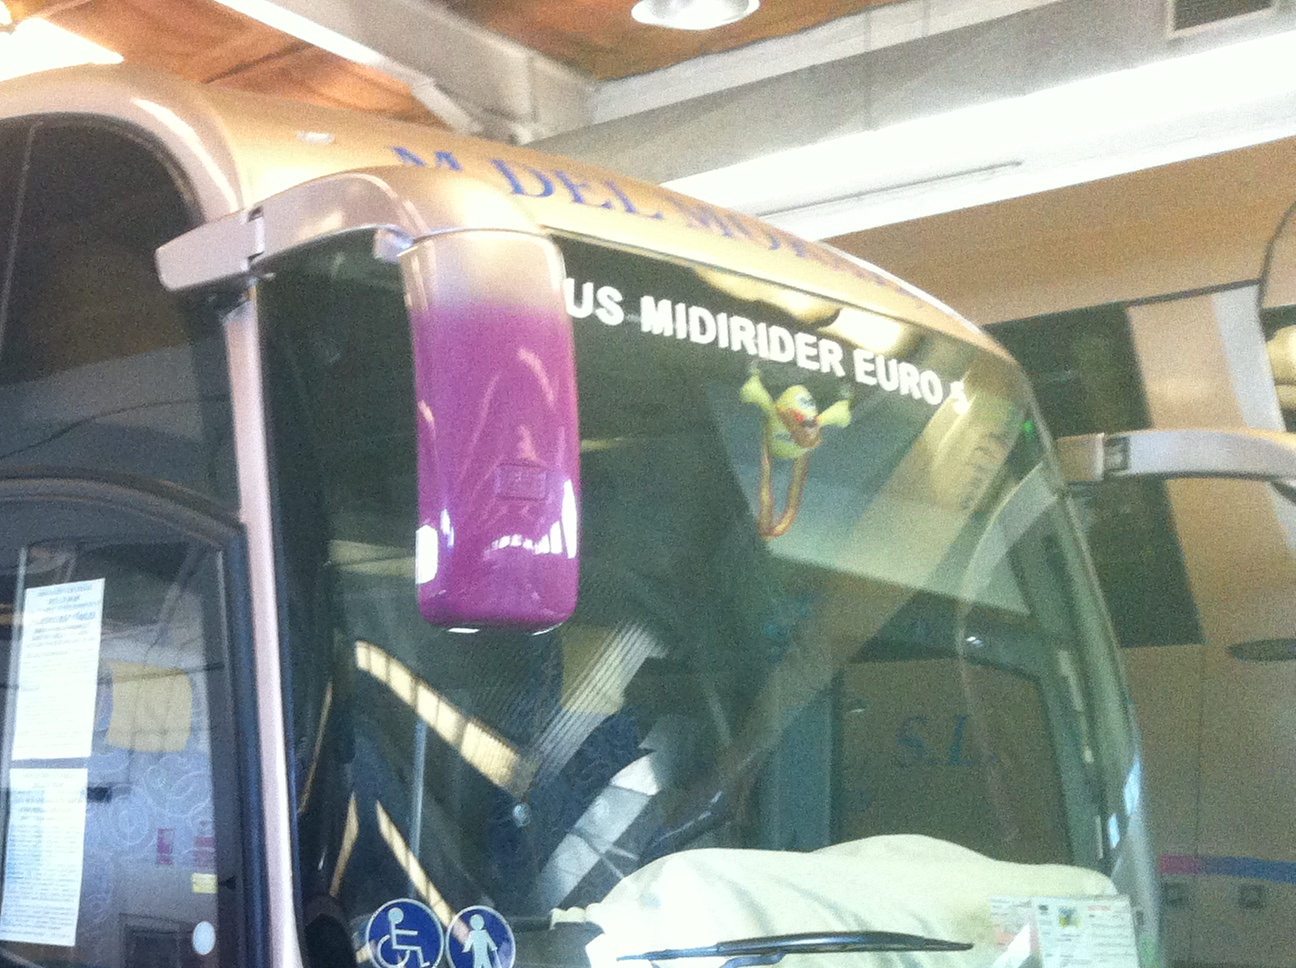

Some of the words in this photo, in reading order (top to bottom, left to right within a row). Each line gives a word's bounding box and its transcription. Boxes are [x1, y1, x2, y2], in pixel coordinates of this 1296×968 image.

[489, 157, 664, 220] DEL
[639, 295, 845, 377] MIDIRIDER
[852, 347, 944, 406] EURO
